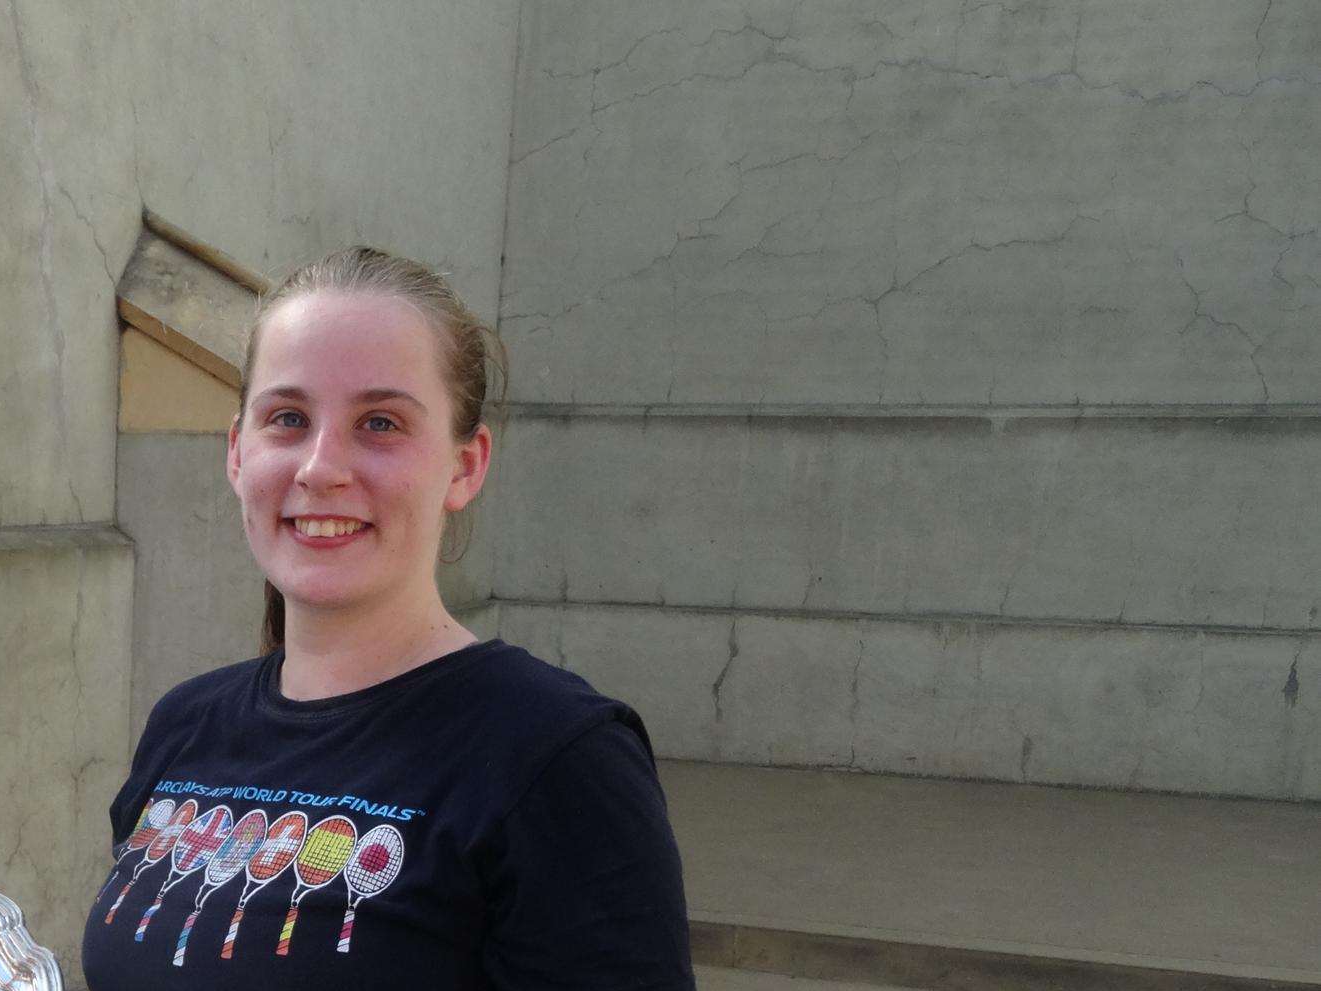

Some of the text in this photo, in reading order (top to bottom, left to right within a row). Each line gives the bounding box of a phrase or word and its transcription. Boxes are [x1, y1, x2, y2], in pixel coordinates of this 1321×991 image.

[154, 780, 211, 796] ARCLAYS
[205, 787, 234, 798] ATP
[233, 786, 288, 802] WORLD
